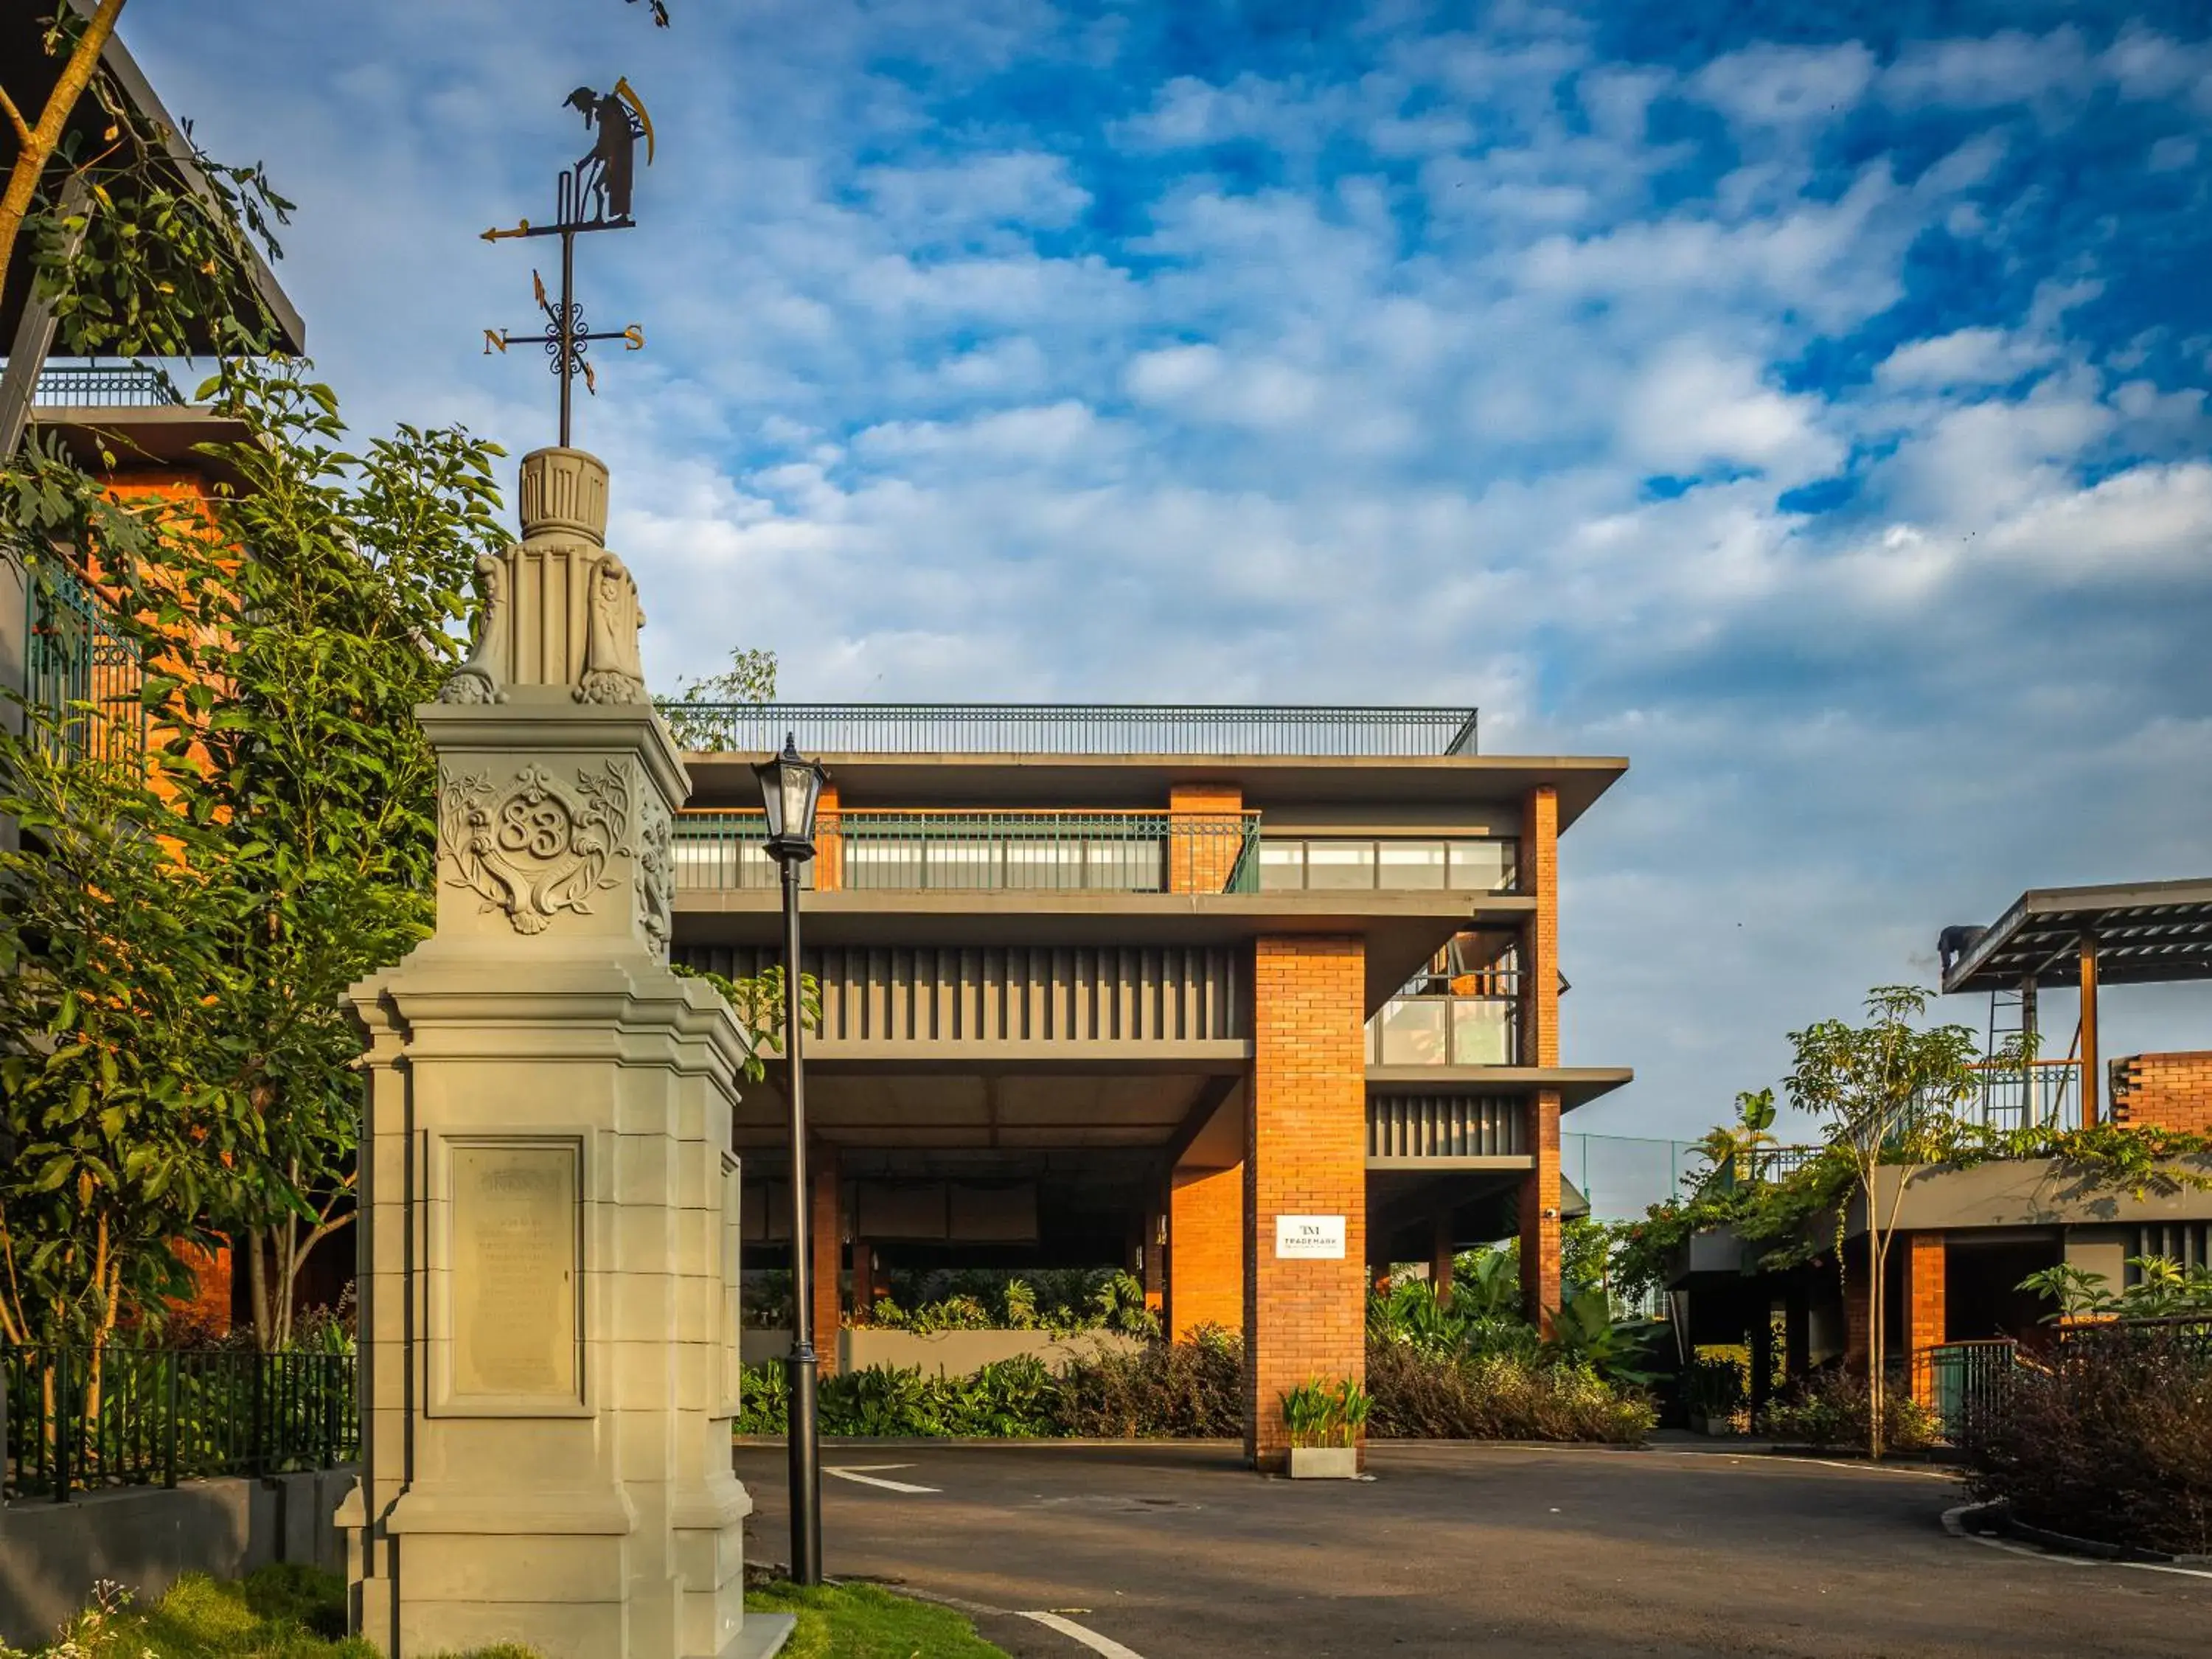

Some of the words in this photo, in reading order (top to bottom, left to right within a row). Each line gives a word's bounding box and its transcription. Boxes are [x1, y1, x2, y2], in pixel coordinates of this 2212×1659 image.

[483, 329, 508, 355] N
[624, 324, 646, 350] S
[1299, 1225, 1320, 1236] TM
